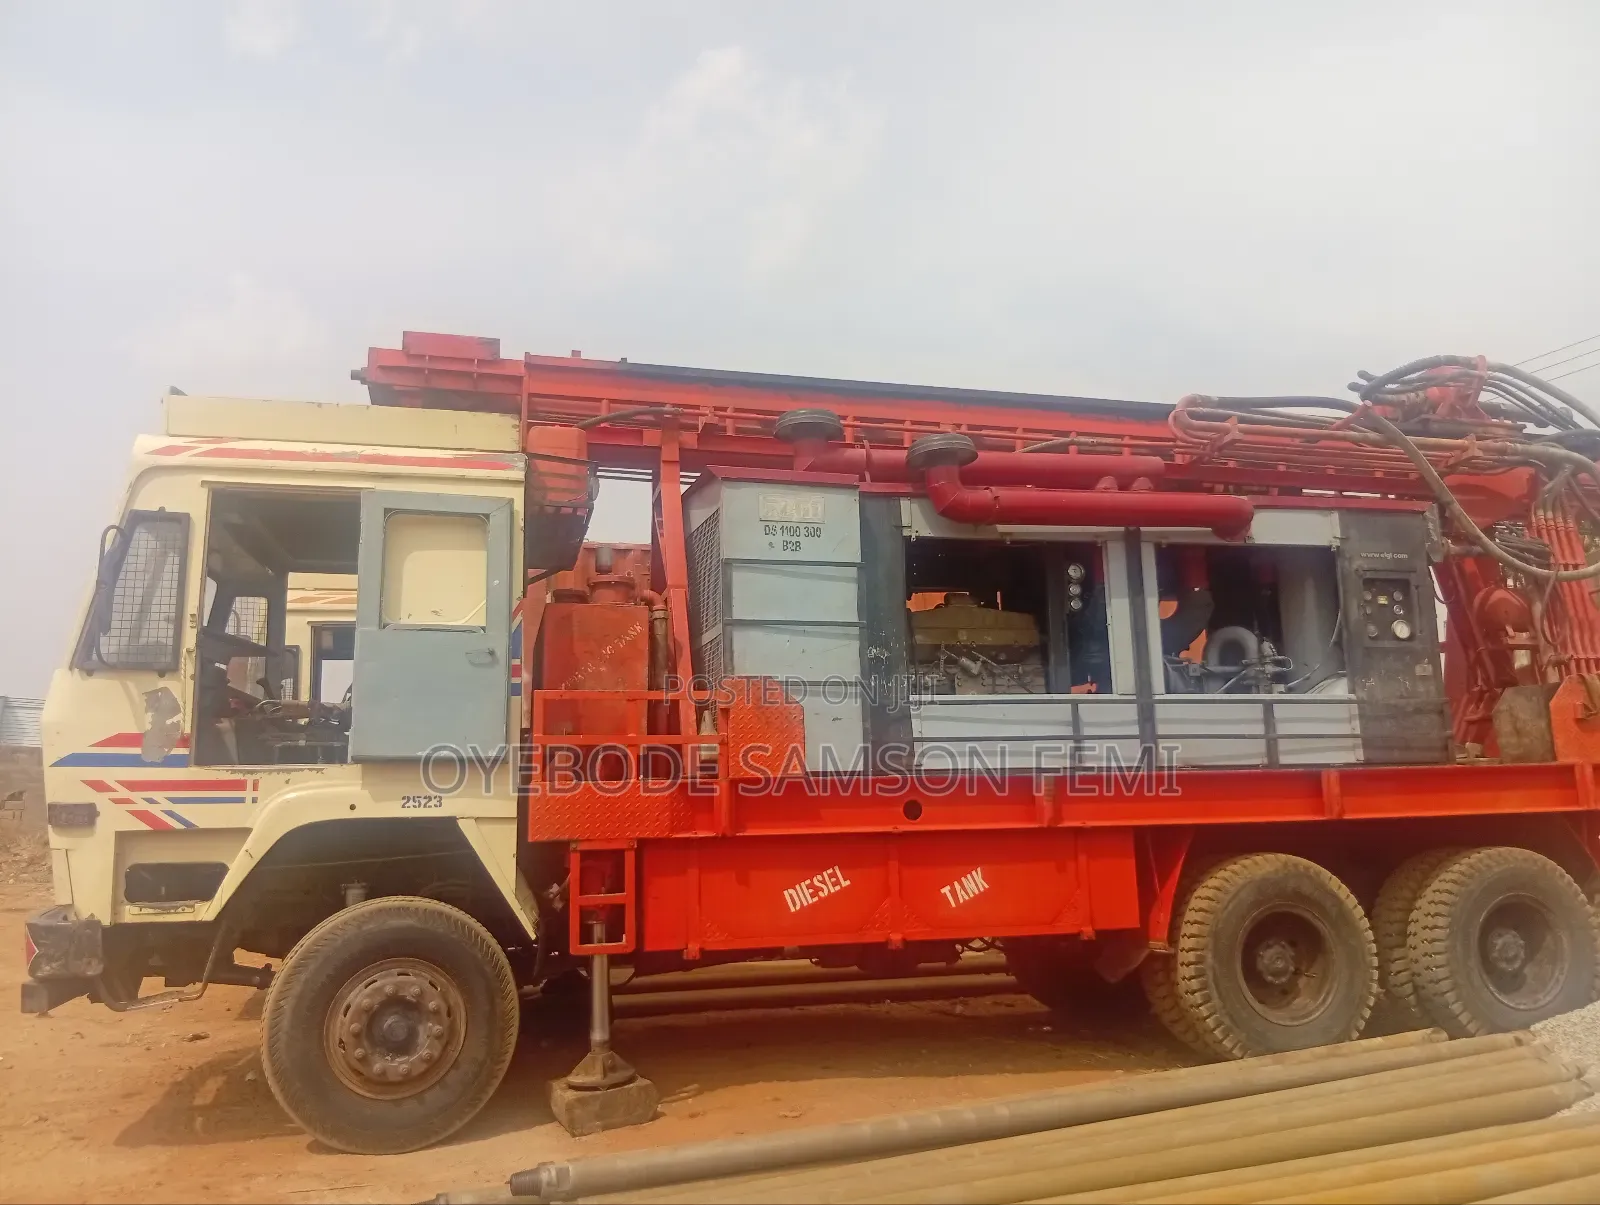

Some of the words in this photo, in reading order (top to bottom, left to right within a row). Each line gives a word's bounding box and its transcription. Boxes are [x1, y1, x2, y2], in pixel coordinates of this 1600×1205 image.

[779, 525, 801, 538] 1100
[803, 526, 822, 539] 300
[401, 795, 443, 809] 2523
[783, 865, 851, 913] DIESEL
[940, 866, 990, 908] TANK
